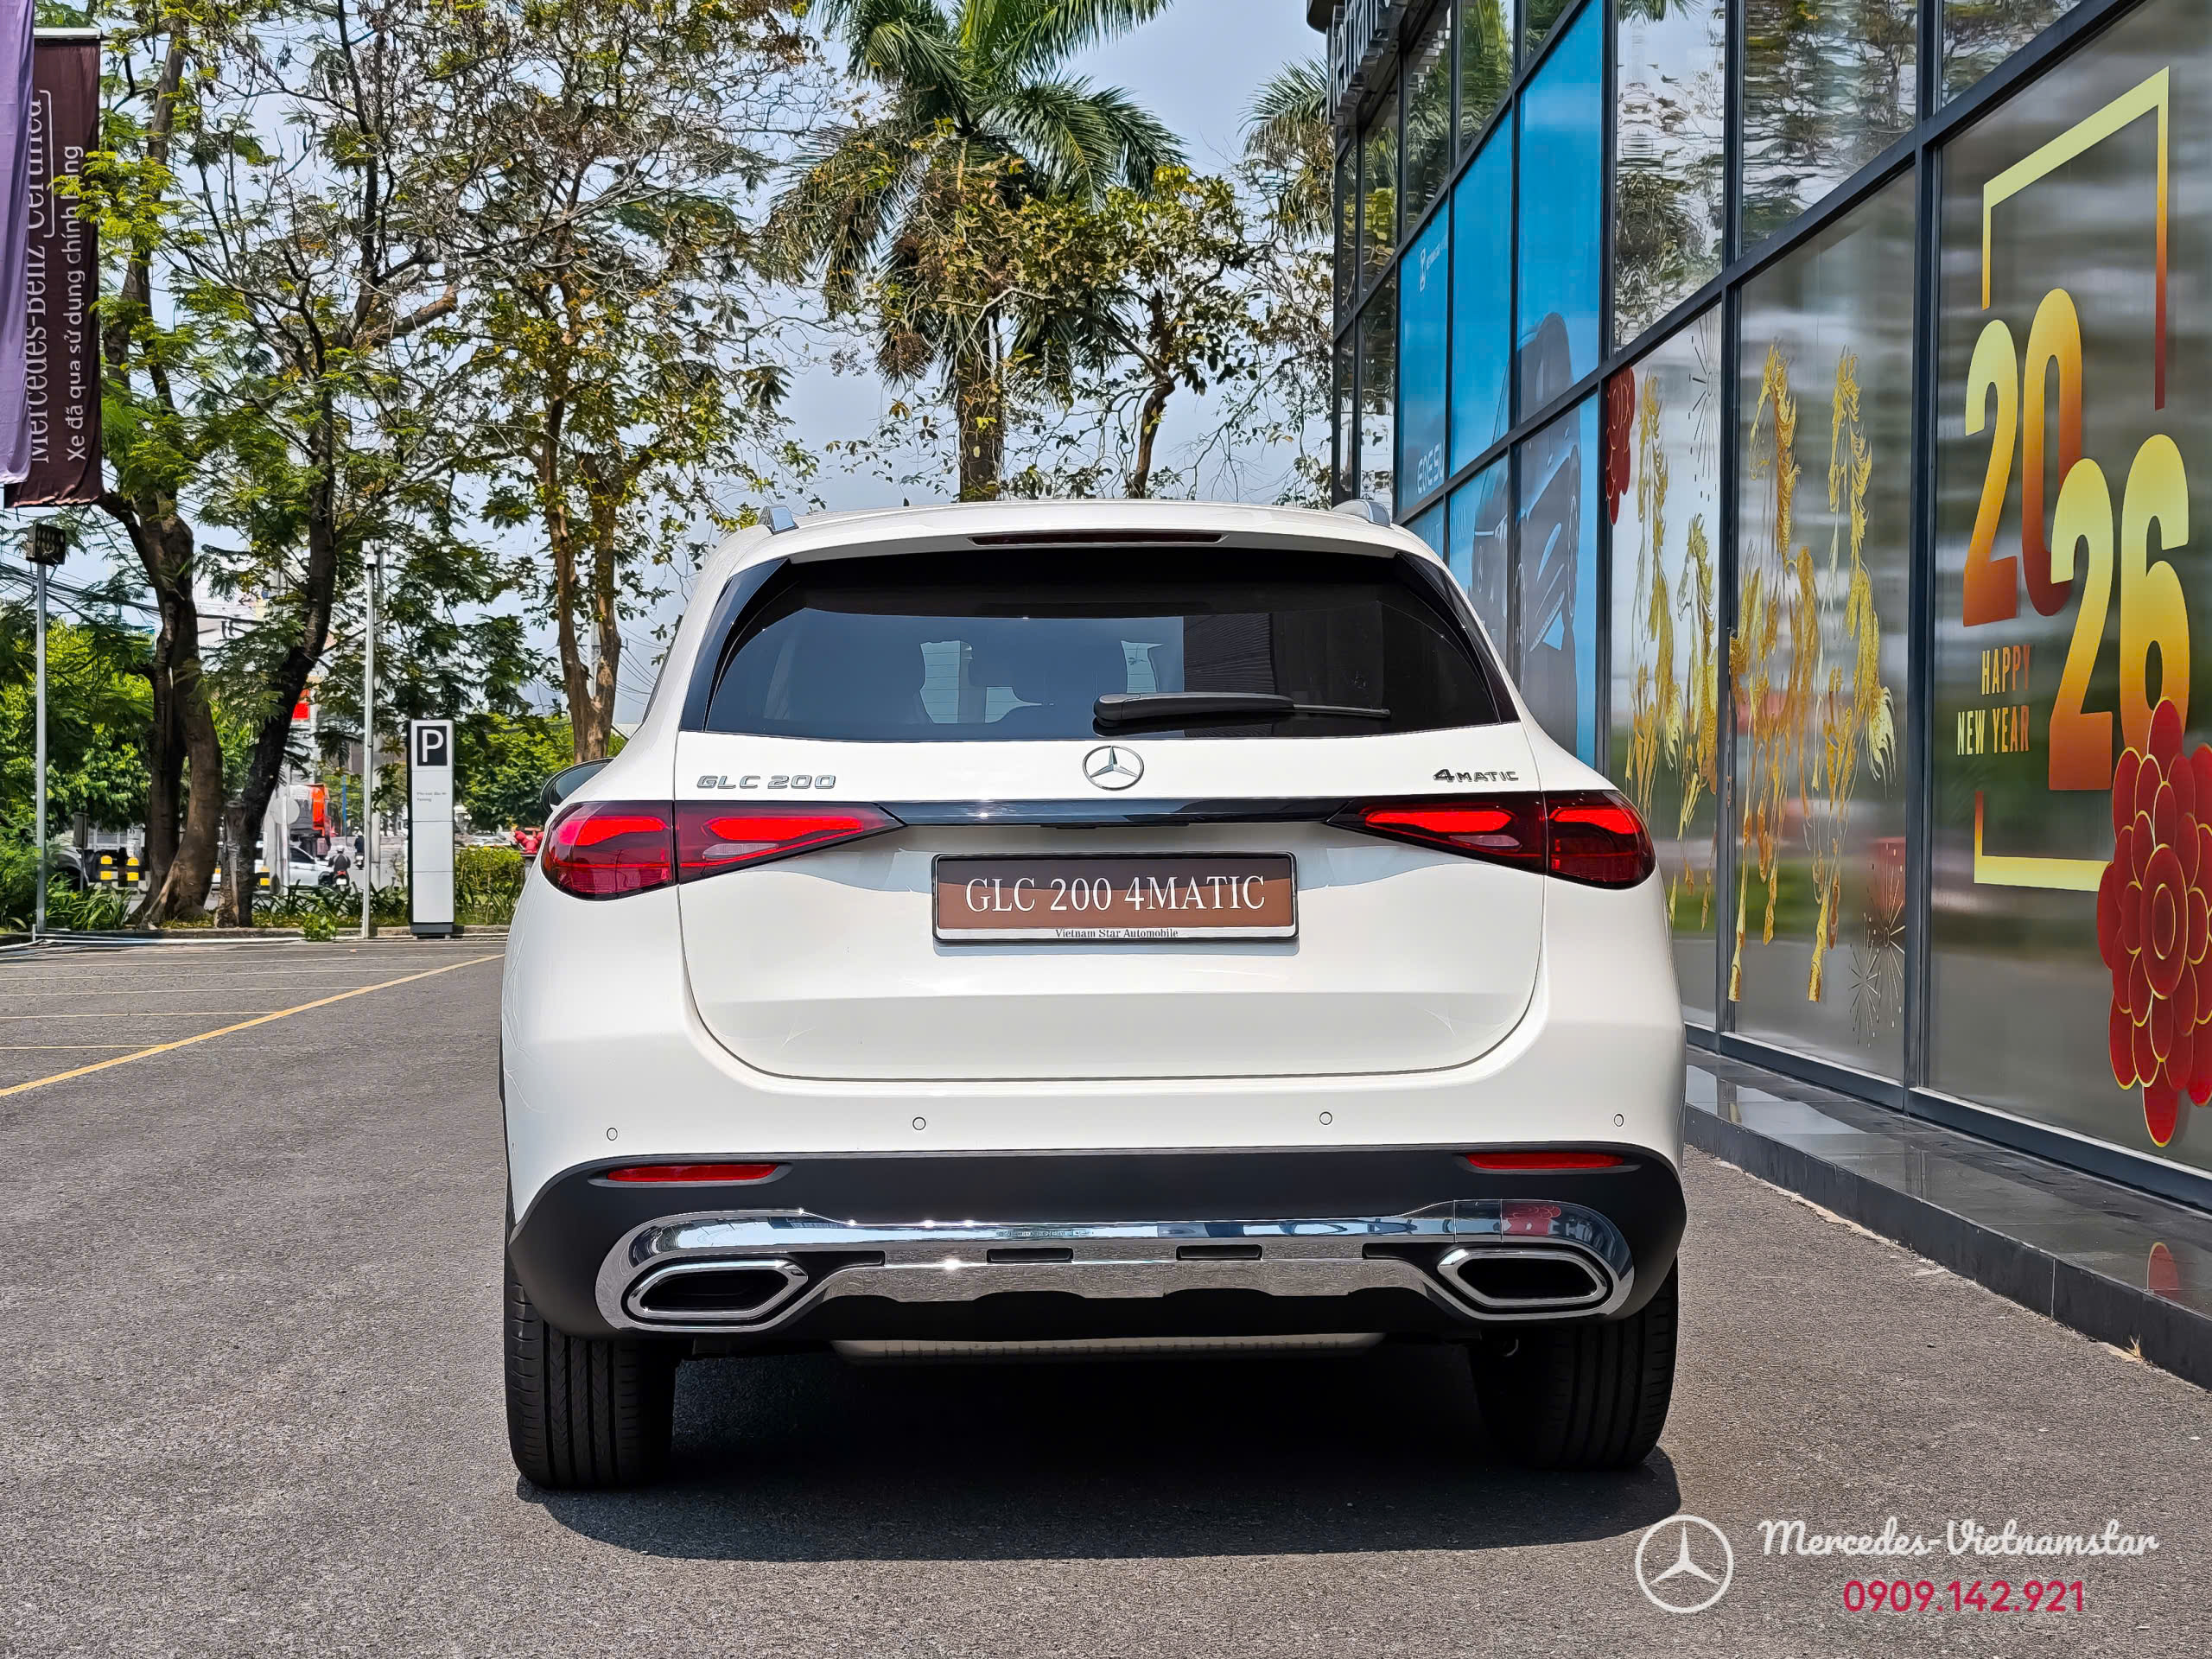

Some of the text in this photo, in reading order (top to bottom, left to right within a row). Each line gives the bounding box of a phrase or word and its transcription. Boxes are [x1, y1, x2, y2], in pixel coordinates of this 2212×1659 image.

[60, 207, 82, 265] chính
[64, 270, 85, 327] dụng
[63, 329, 81, 356] sử
[67, 361, 85, 401] qua
[64, 405, 83, 430] đã
[66, 435, 85, 462] Xe
[1981, 644, 2030, 696] HAPPY
[422, 729, 444, 763] P
[1957, 704, 2030, 756] NEW YEAR
[696, 774, 836, 790] GLC 200
[1433, 768, 1520, 783] 4MATIC
[964, 875, 1266, 912] GLC 200 4MATIC
[1055, 929, 1179, 938] Vietnam Star Automobile
